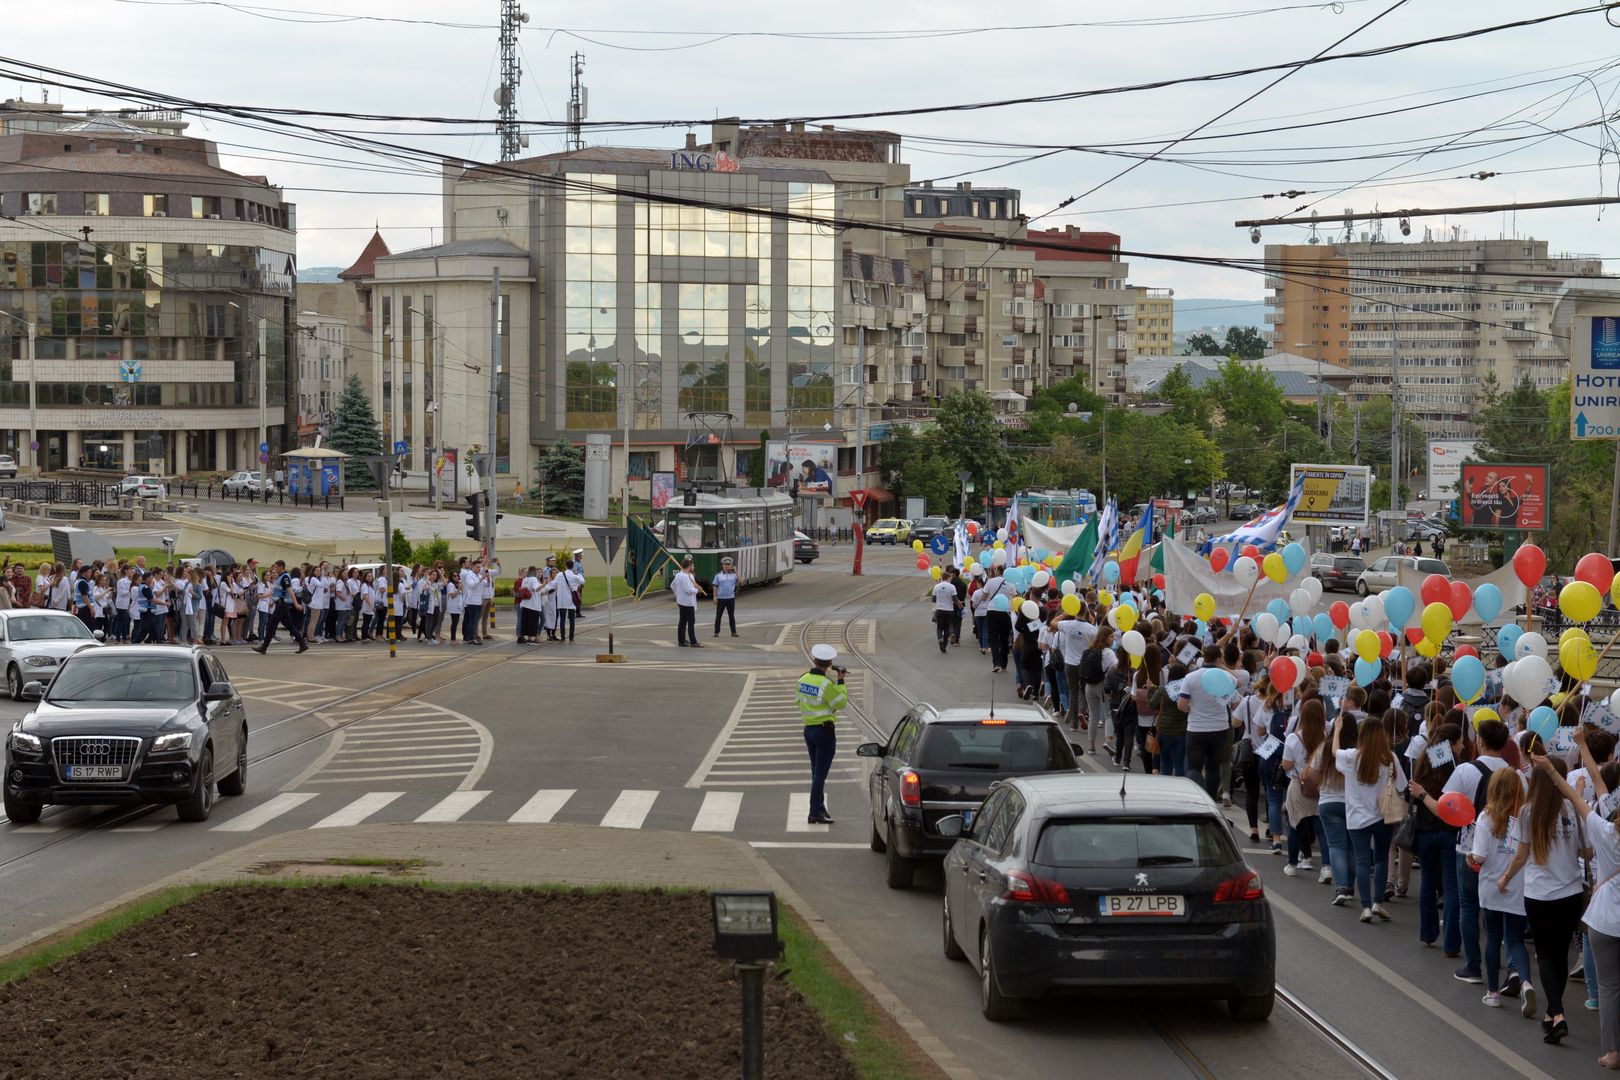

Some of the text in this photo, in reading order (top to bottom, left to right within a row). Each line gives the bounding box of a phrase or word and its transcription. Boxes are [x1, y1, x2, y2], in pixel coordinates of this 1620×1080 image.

[671, 152, 710, 171] ING
[1576, 374, 1620, 388] HOT
[1574, 395, 1620, 407] UNIR
[97, 411, 163, 420] UNIVERSITATEA
[1588, 425, 1614, 435] 700
[73, 767, 120, 777] IS 17 RWP
[1111, 897, 1178, 911] B 27 LPB
